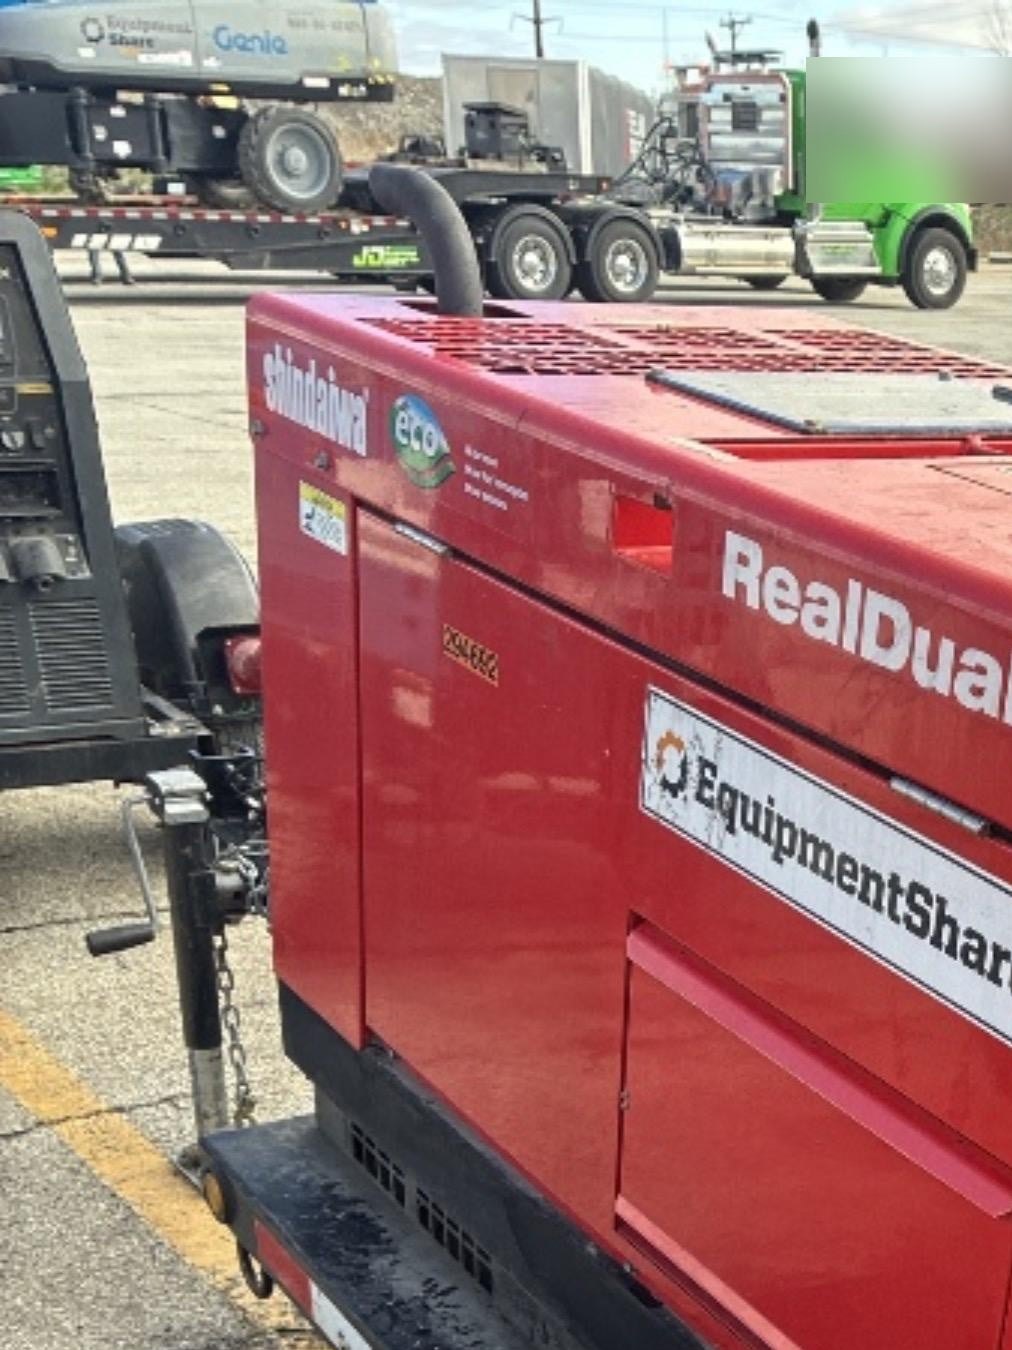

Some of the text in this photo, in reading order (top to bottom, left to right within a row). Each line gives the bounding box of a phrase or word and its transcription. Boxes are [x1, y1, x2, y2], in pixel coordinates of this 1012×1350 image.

[108, 33, 155, 49] Share
[212, 24, 289, 55] Genie
[396, 408, 438, 458] eco
